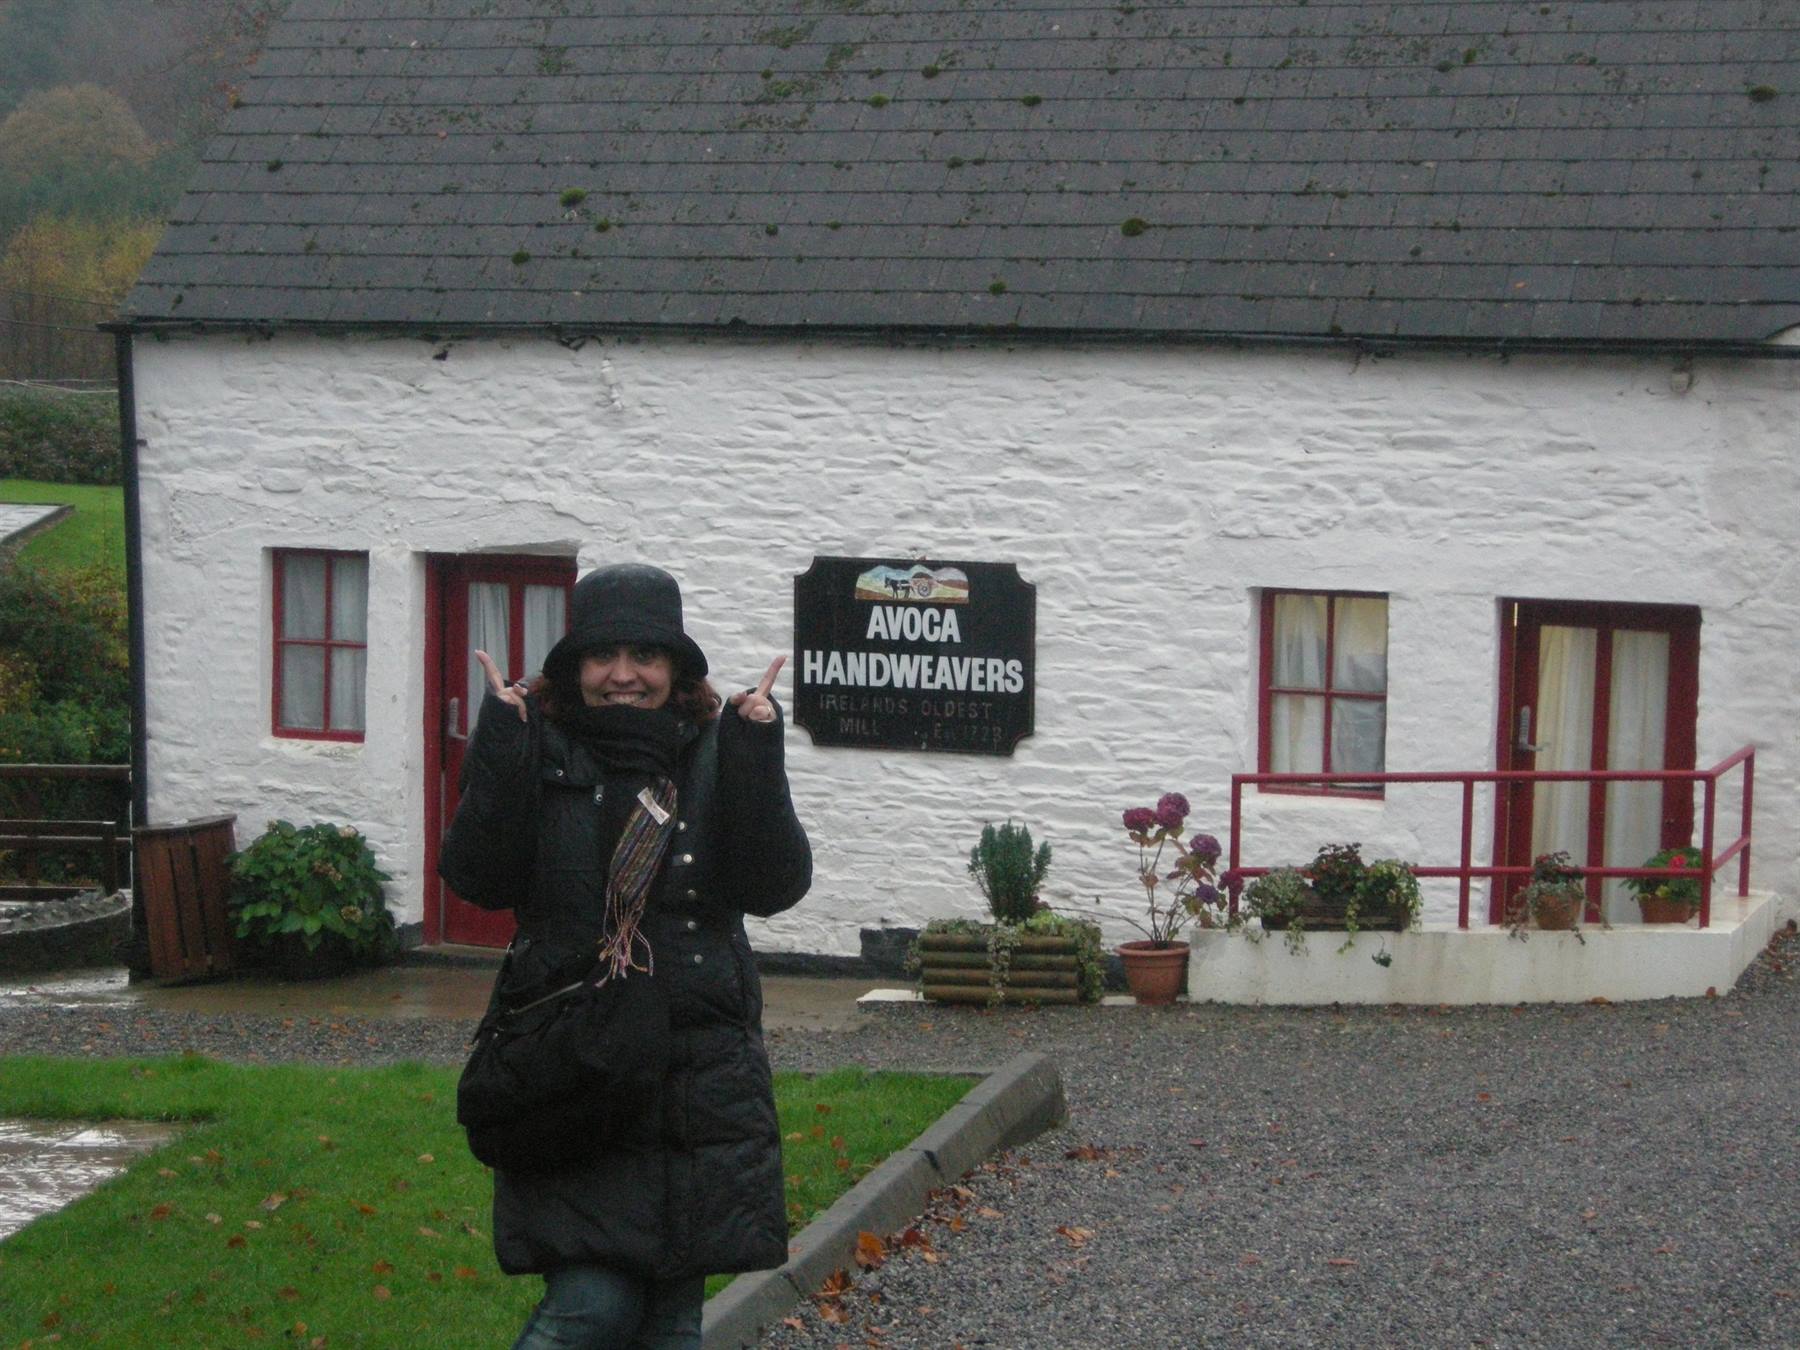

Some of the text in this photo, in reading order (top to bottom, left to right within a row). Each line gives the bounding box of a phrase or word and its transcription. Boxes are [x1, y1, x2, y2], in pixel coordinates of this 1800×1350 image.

[866, 605, 961, 643] AVOCA
[803, 649, 1024, 693] HANDWEAVERS
[921, 700, 993, 719] OLDEST
[840, 718, 880, 735] MILL
